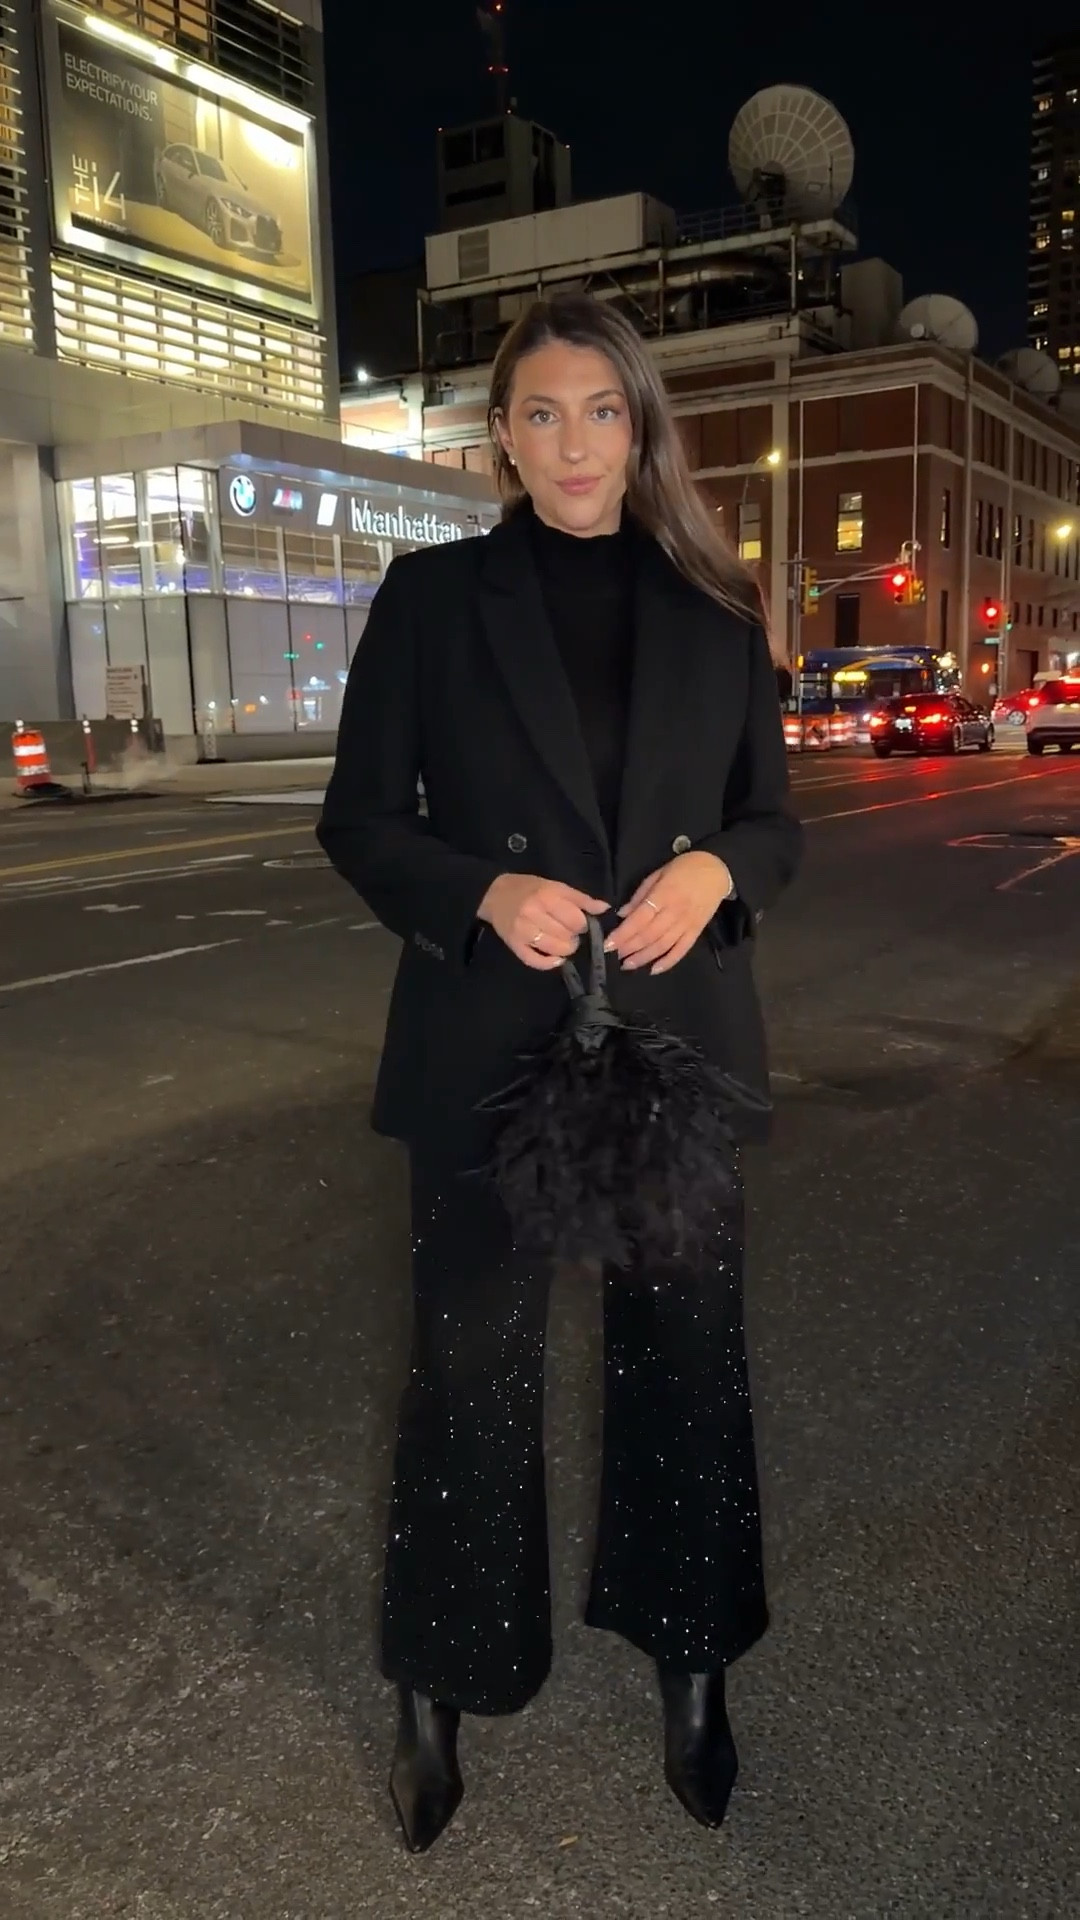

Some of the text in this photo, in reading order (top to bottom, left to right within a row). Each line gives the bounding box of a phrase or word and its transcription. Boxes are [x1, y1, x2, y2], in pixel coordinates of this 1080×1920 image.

[64, 52, 158, 106] ELECTRIFY YOUR
[66, 72, 153, 122] EXPECTATIONS.
[72, 154, 91, 206] THE
[91, 161, 126, 221] i4
[350, 497, 463, 544] Manhattan
